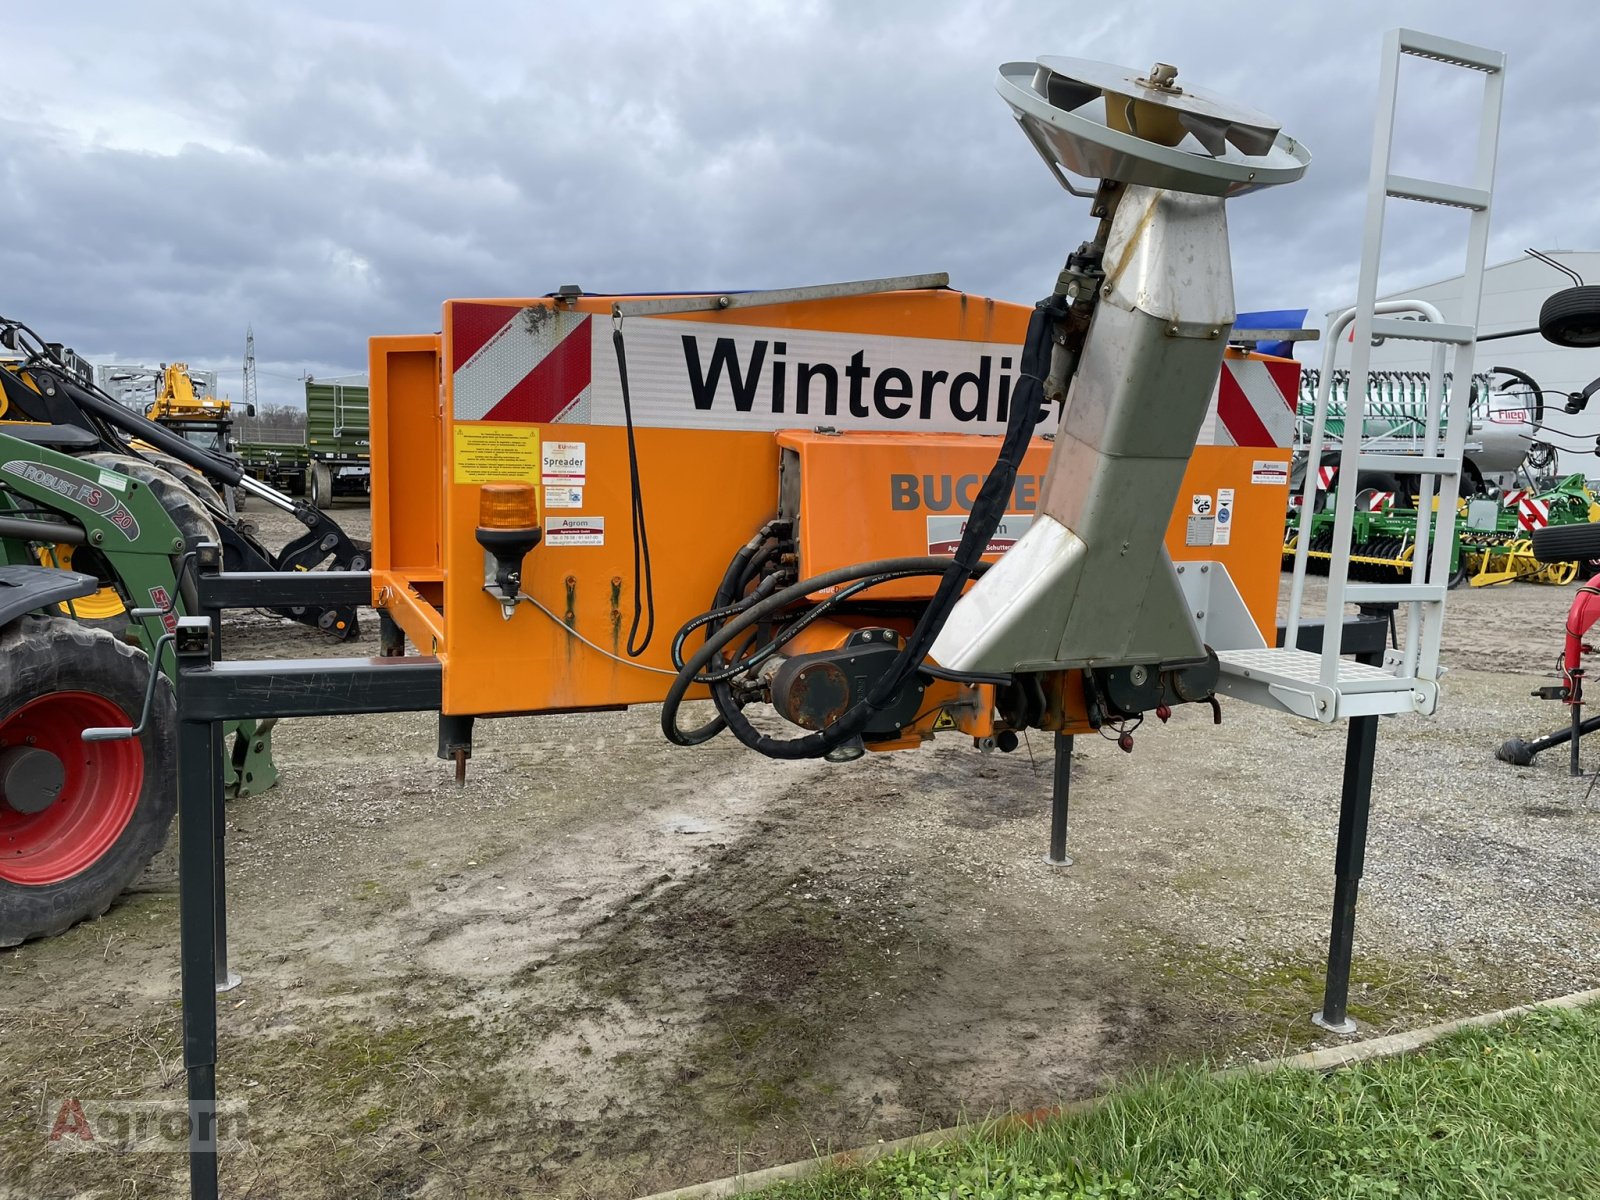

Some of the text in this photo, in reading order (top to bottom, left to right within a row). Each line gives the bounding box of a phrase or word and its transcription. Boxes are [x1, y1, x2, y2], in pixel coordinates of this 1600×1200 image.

[681, 335, 1062, 425] Winterdi
[544, 457, 584, 467] Spreader
[23, 465, 78, 496] ROBUST
[76, 484, 102, 507] FS
[891, 474, 1047, 511] BUCE
[112, 509, 133, 529] 20
